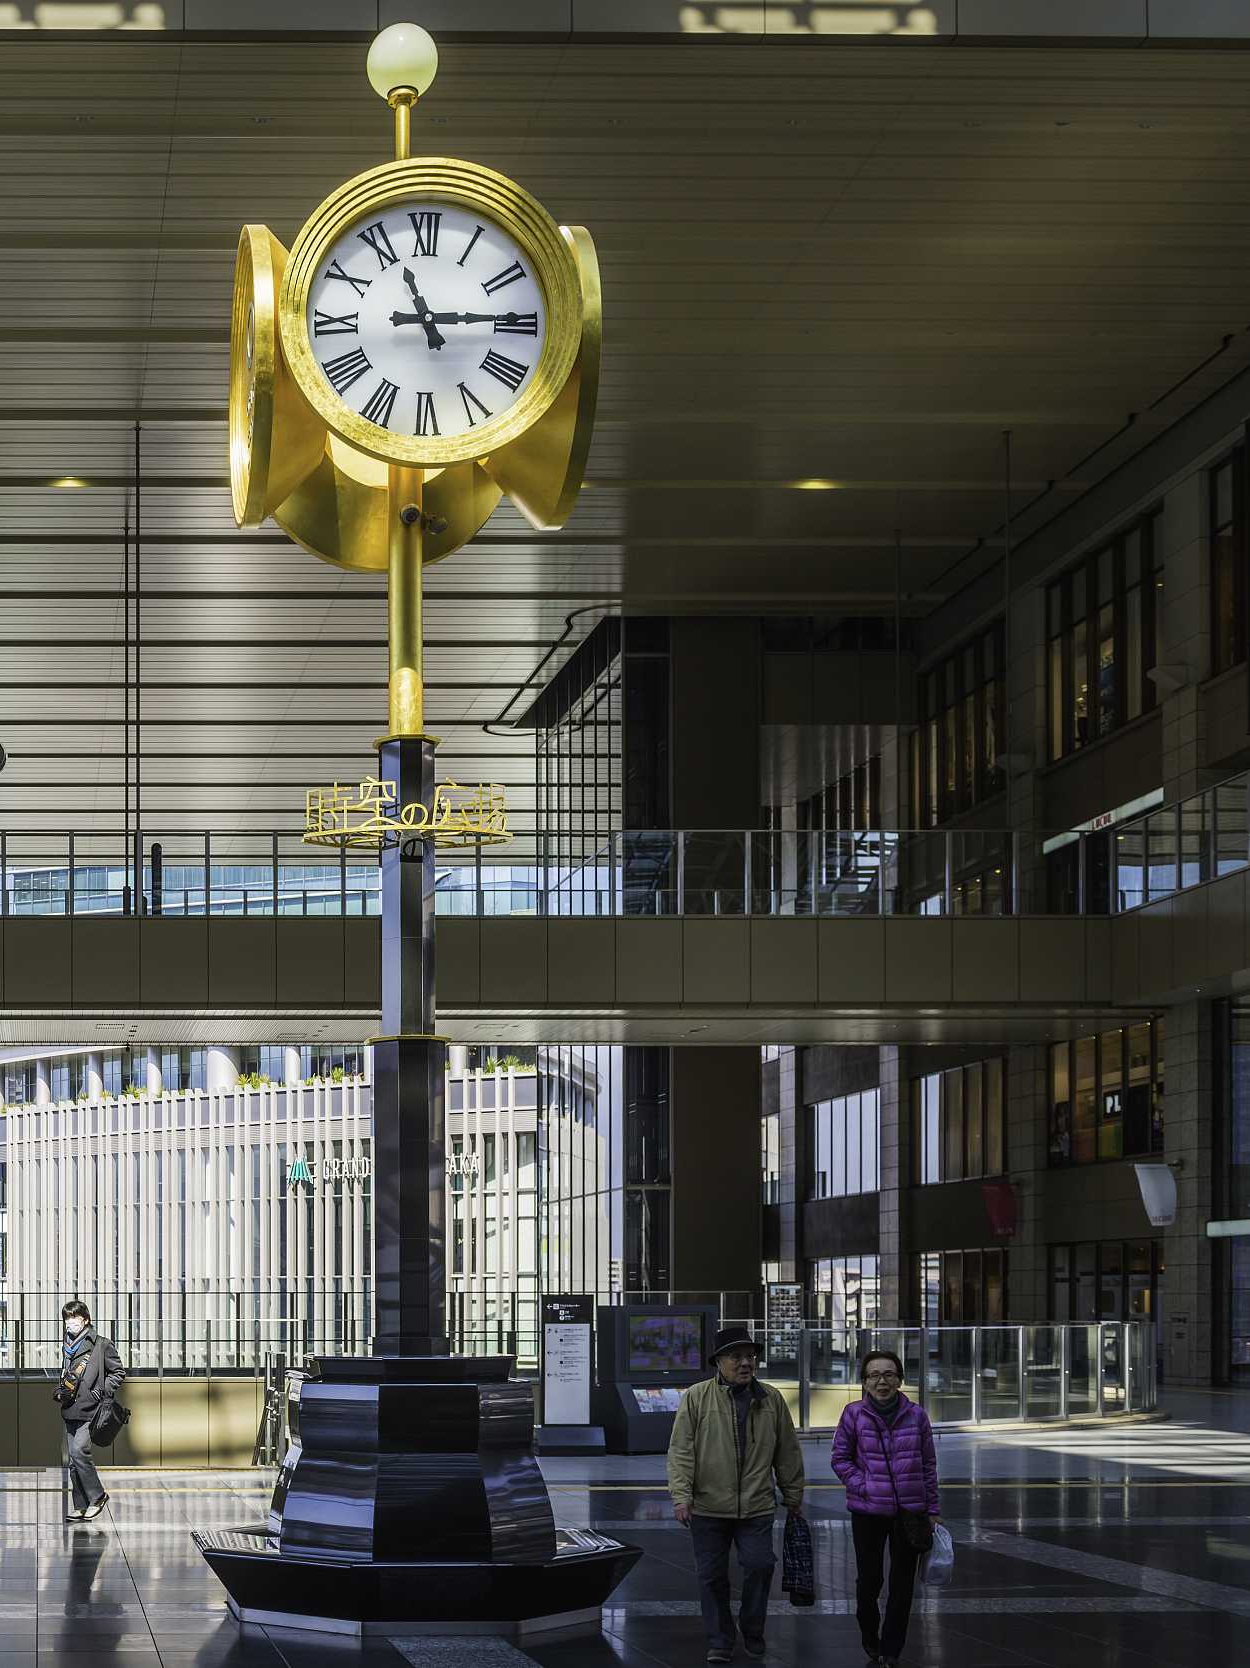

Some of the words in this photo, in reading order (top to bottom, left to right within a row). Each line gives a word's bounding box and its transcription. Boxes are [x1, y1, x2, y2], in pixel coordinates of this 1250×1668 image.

[357, 221, 400, 271] XI
[408, 212, 442, 257] XII
[457, 225, 485, 266] I
[325, 259, 372, 298] X
[481, 260, 527, 296] II
[314, 309, 359, 338] IX
[359, 378, 400, 429] VII
[414, 392, 441, 436] VI
[457, 382, 492, 427] V
[323, 1157, 369, 1180] GRAND
[446, 1151, 479, 1175] AKA
